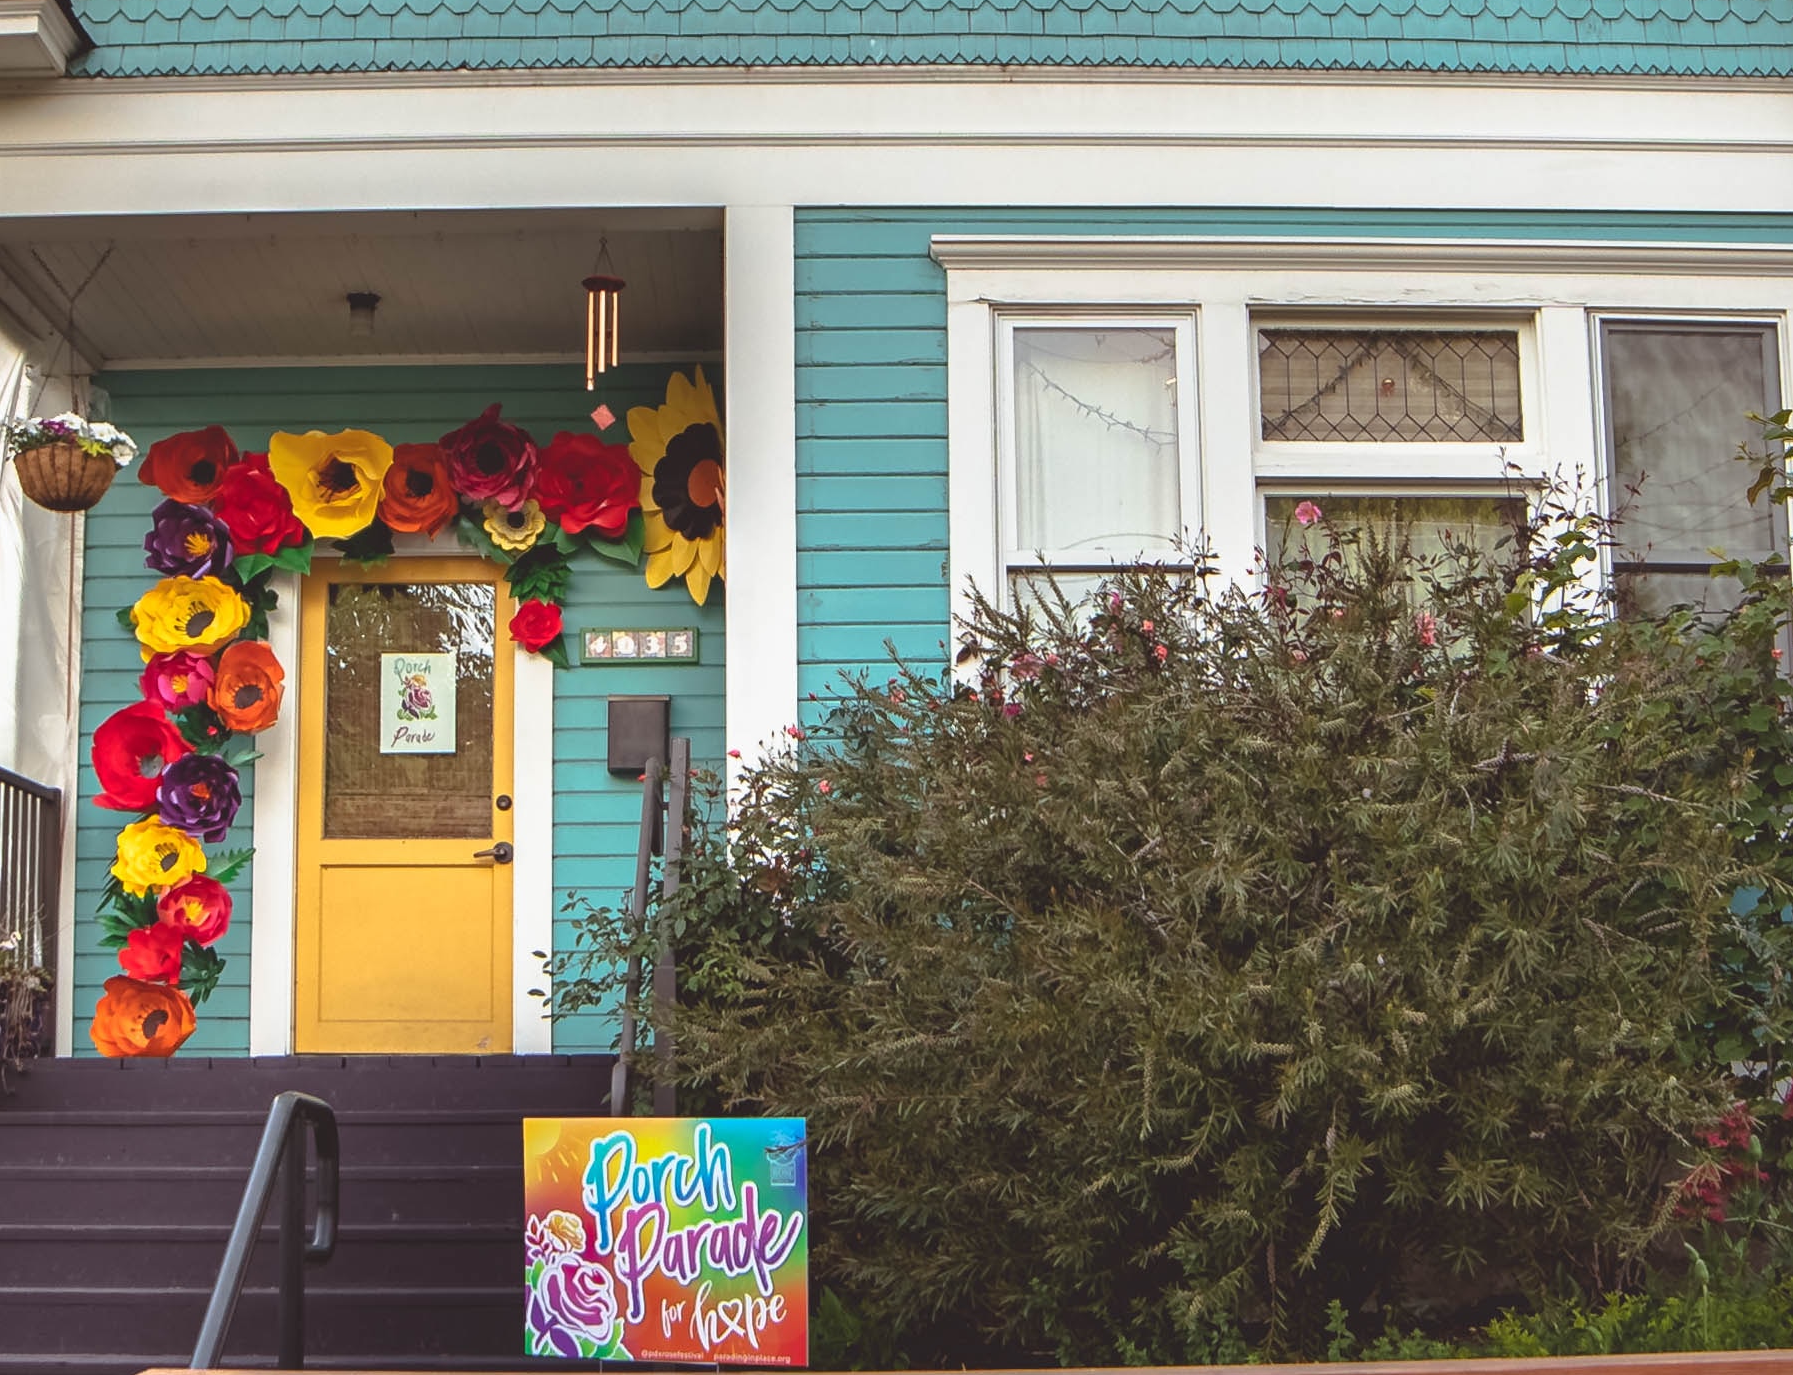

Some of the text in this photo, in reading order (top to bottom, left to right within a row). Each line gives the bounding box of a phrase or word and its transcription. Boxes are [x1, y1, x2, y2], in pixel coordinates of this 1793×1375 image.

[589, 634, 689, 655] 4035
[394, 658, 432, 686] Porch
[391, 726, 436, 748] Parade
[582, 1124, 737, 1255] Porch
[614, 1181, 804, 1323] Parade
[661, 1280, 787, 1352] for hope
